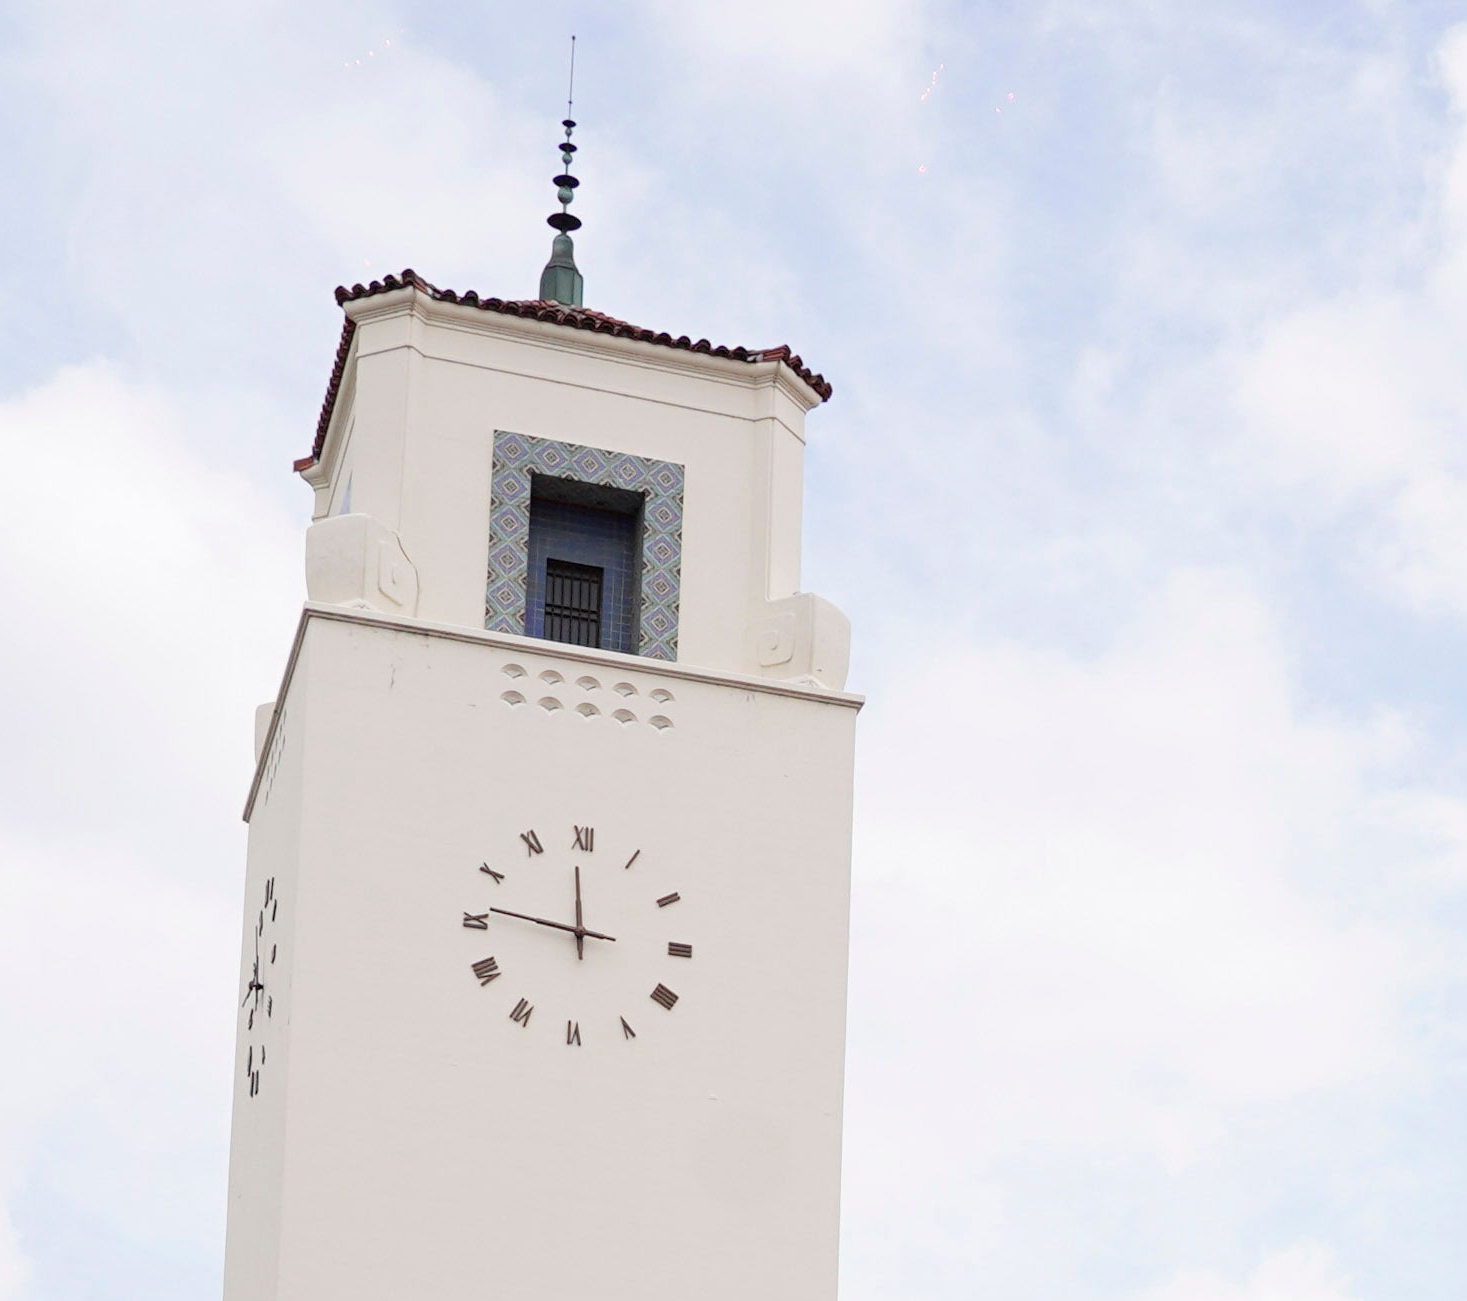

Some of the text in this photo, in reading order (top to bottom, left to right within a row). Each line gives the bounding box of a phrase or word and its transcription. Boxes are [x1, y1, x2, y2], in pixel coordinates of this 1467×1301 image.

[520, 829, 544, 857] XI
[572, 825, 594, 852] XII
[479, 862, 505, 884] X
[656, 892, 681, 908] II
[668, 941, 692, 958] III
[566, 1020, 581, 1046] VI
